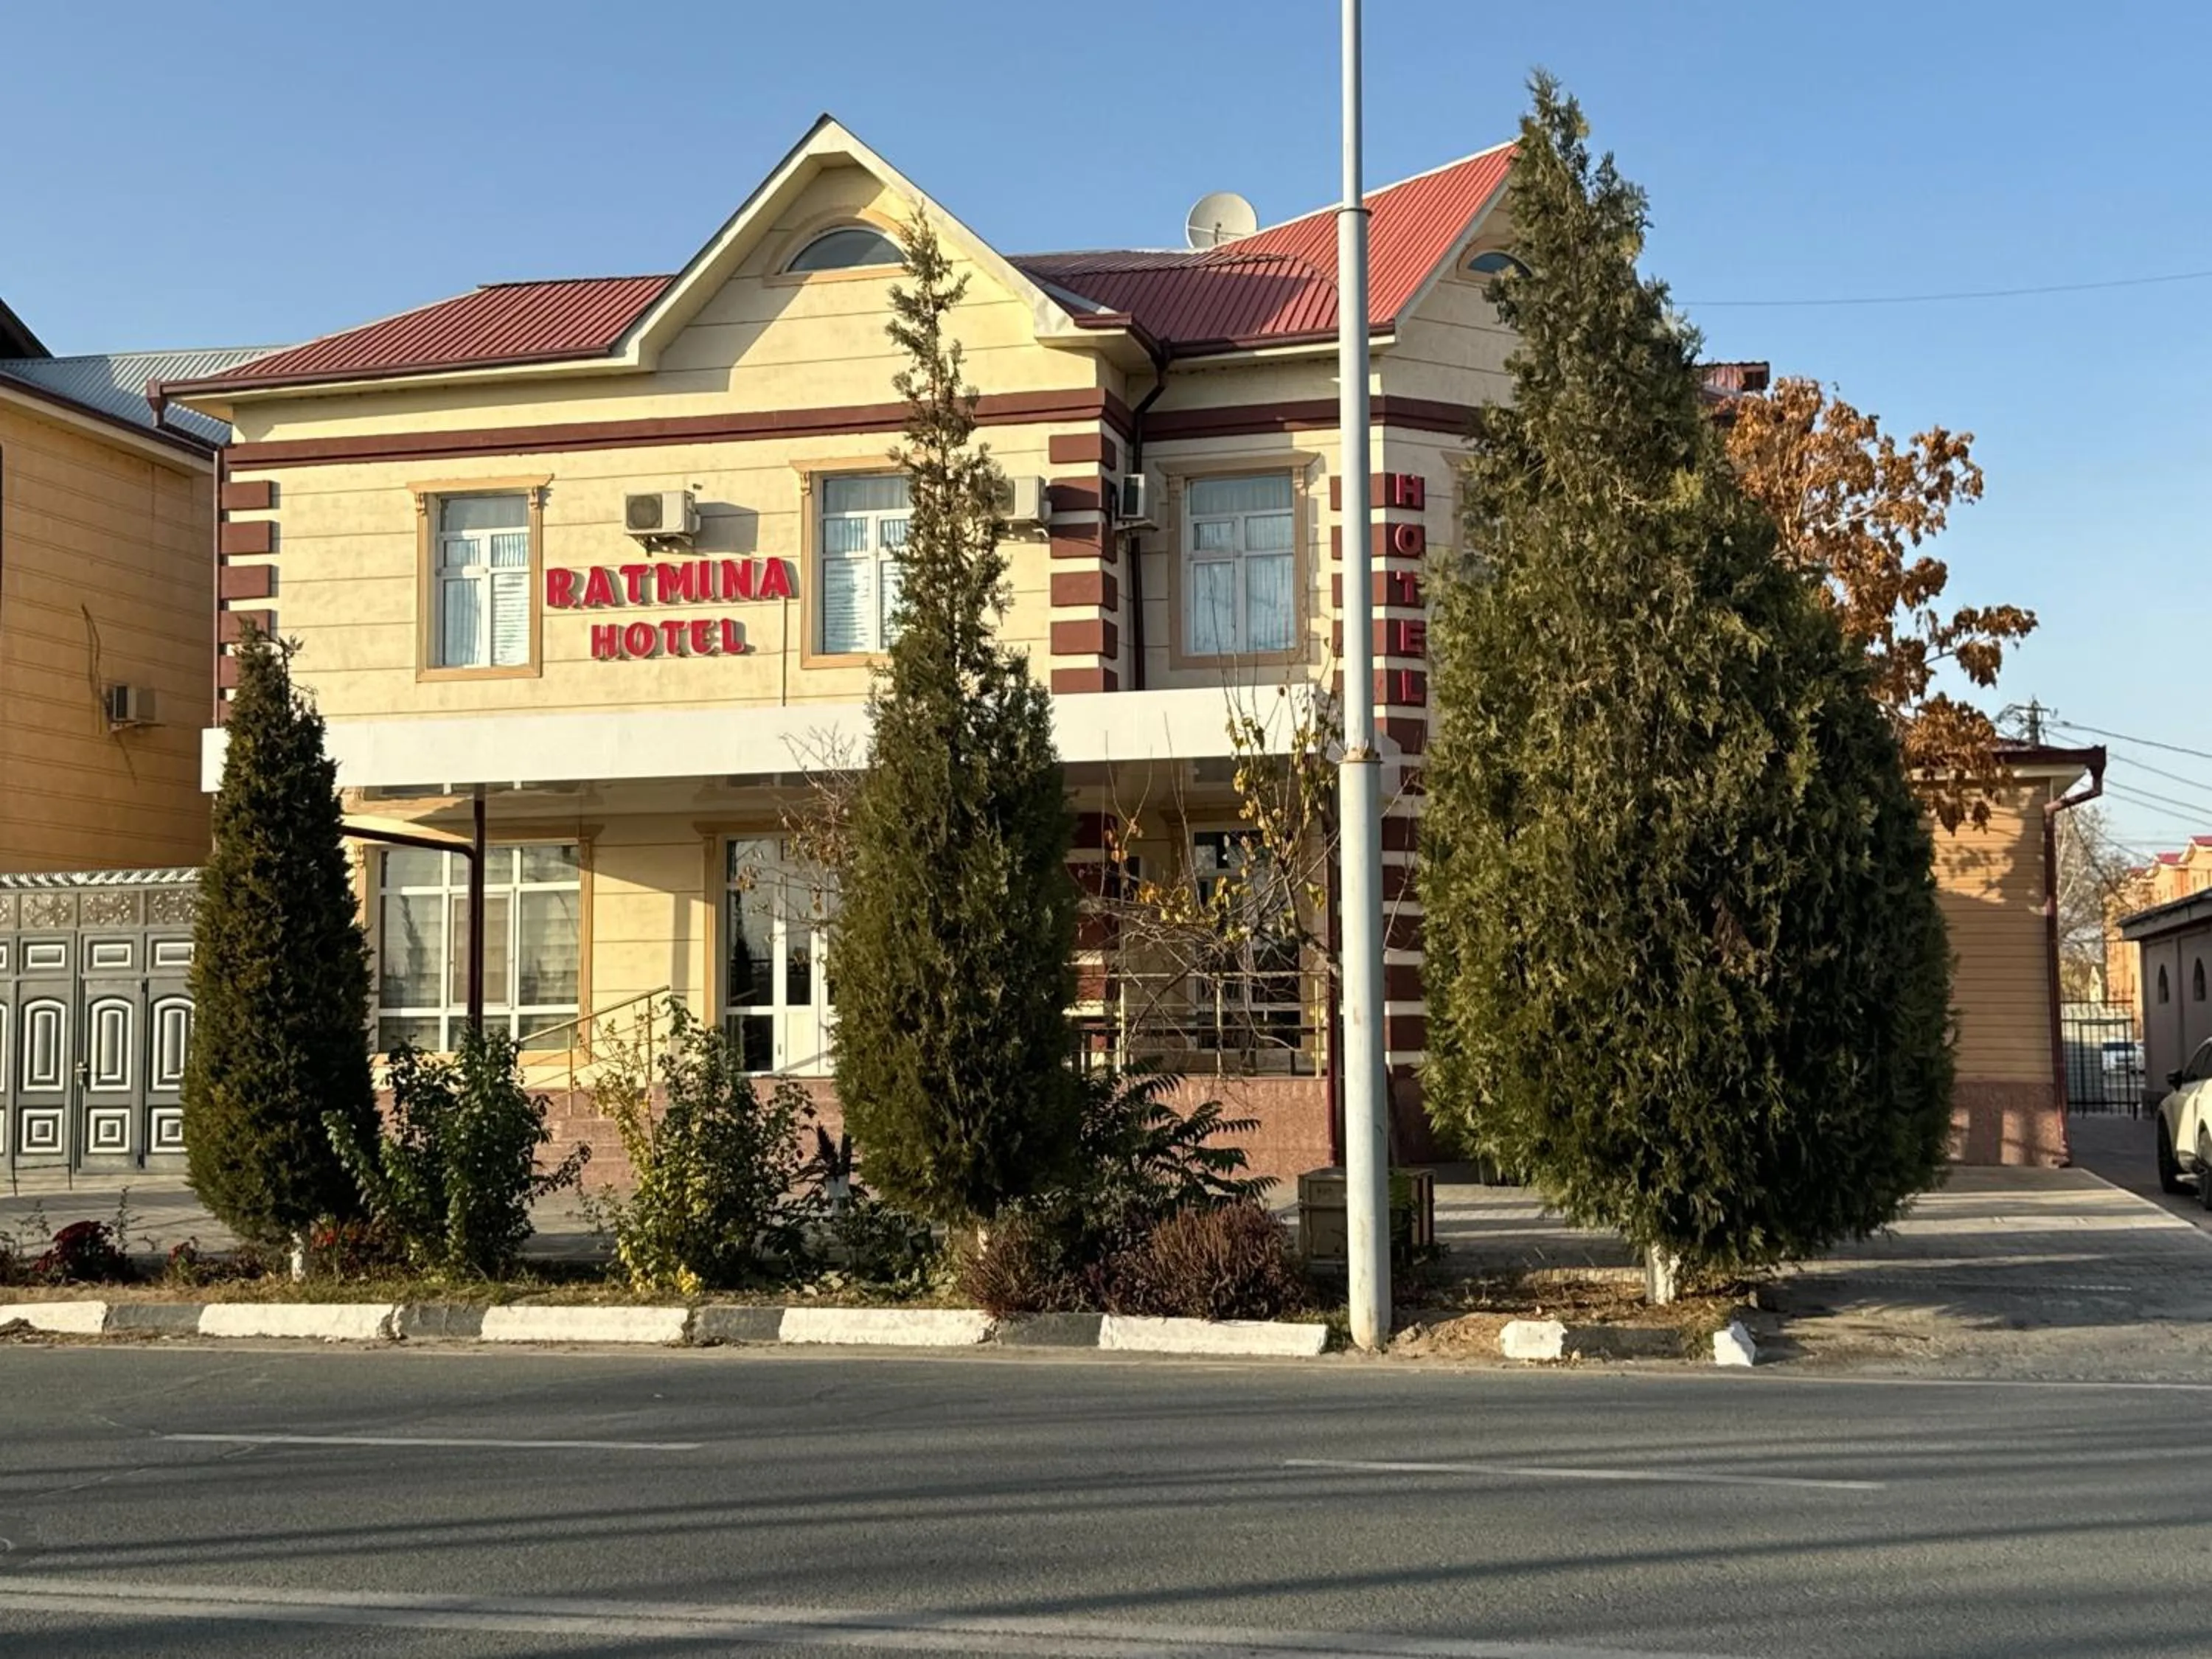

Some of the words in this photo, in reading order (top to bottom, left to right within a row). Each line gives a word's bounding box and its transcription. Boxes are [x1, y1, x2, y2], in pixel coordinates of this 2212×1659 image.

[546, 557, 793, 608] RATMINA
[1394, 473, 1424, 704] HOTEL
[591, 618, 745, 661] HOTEL
